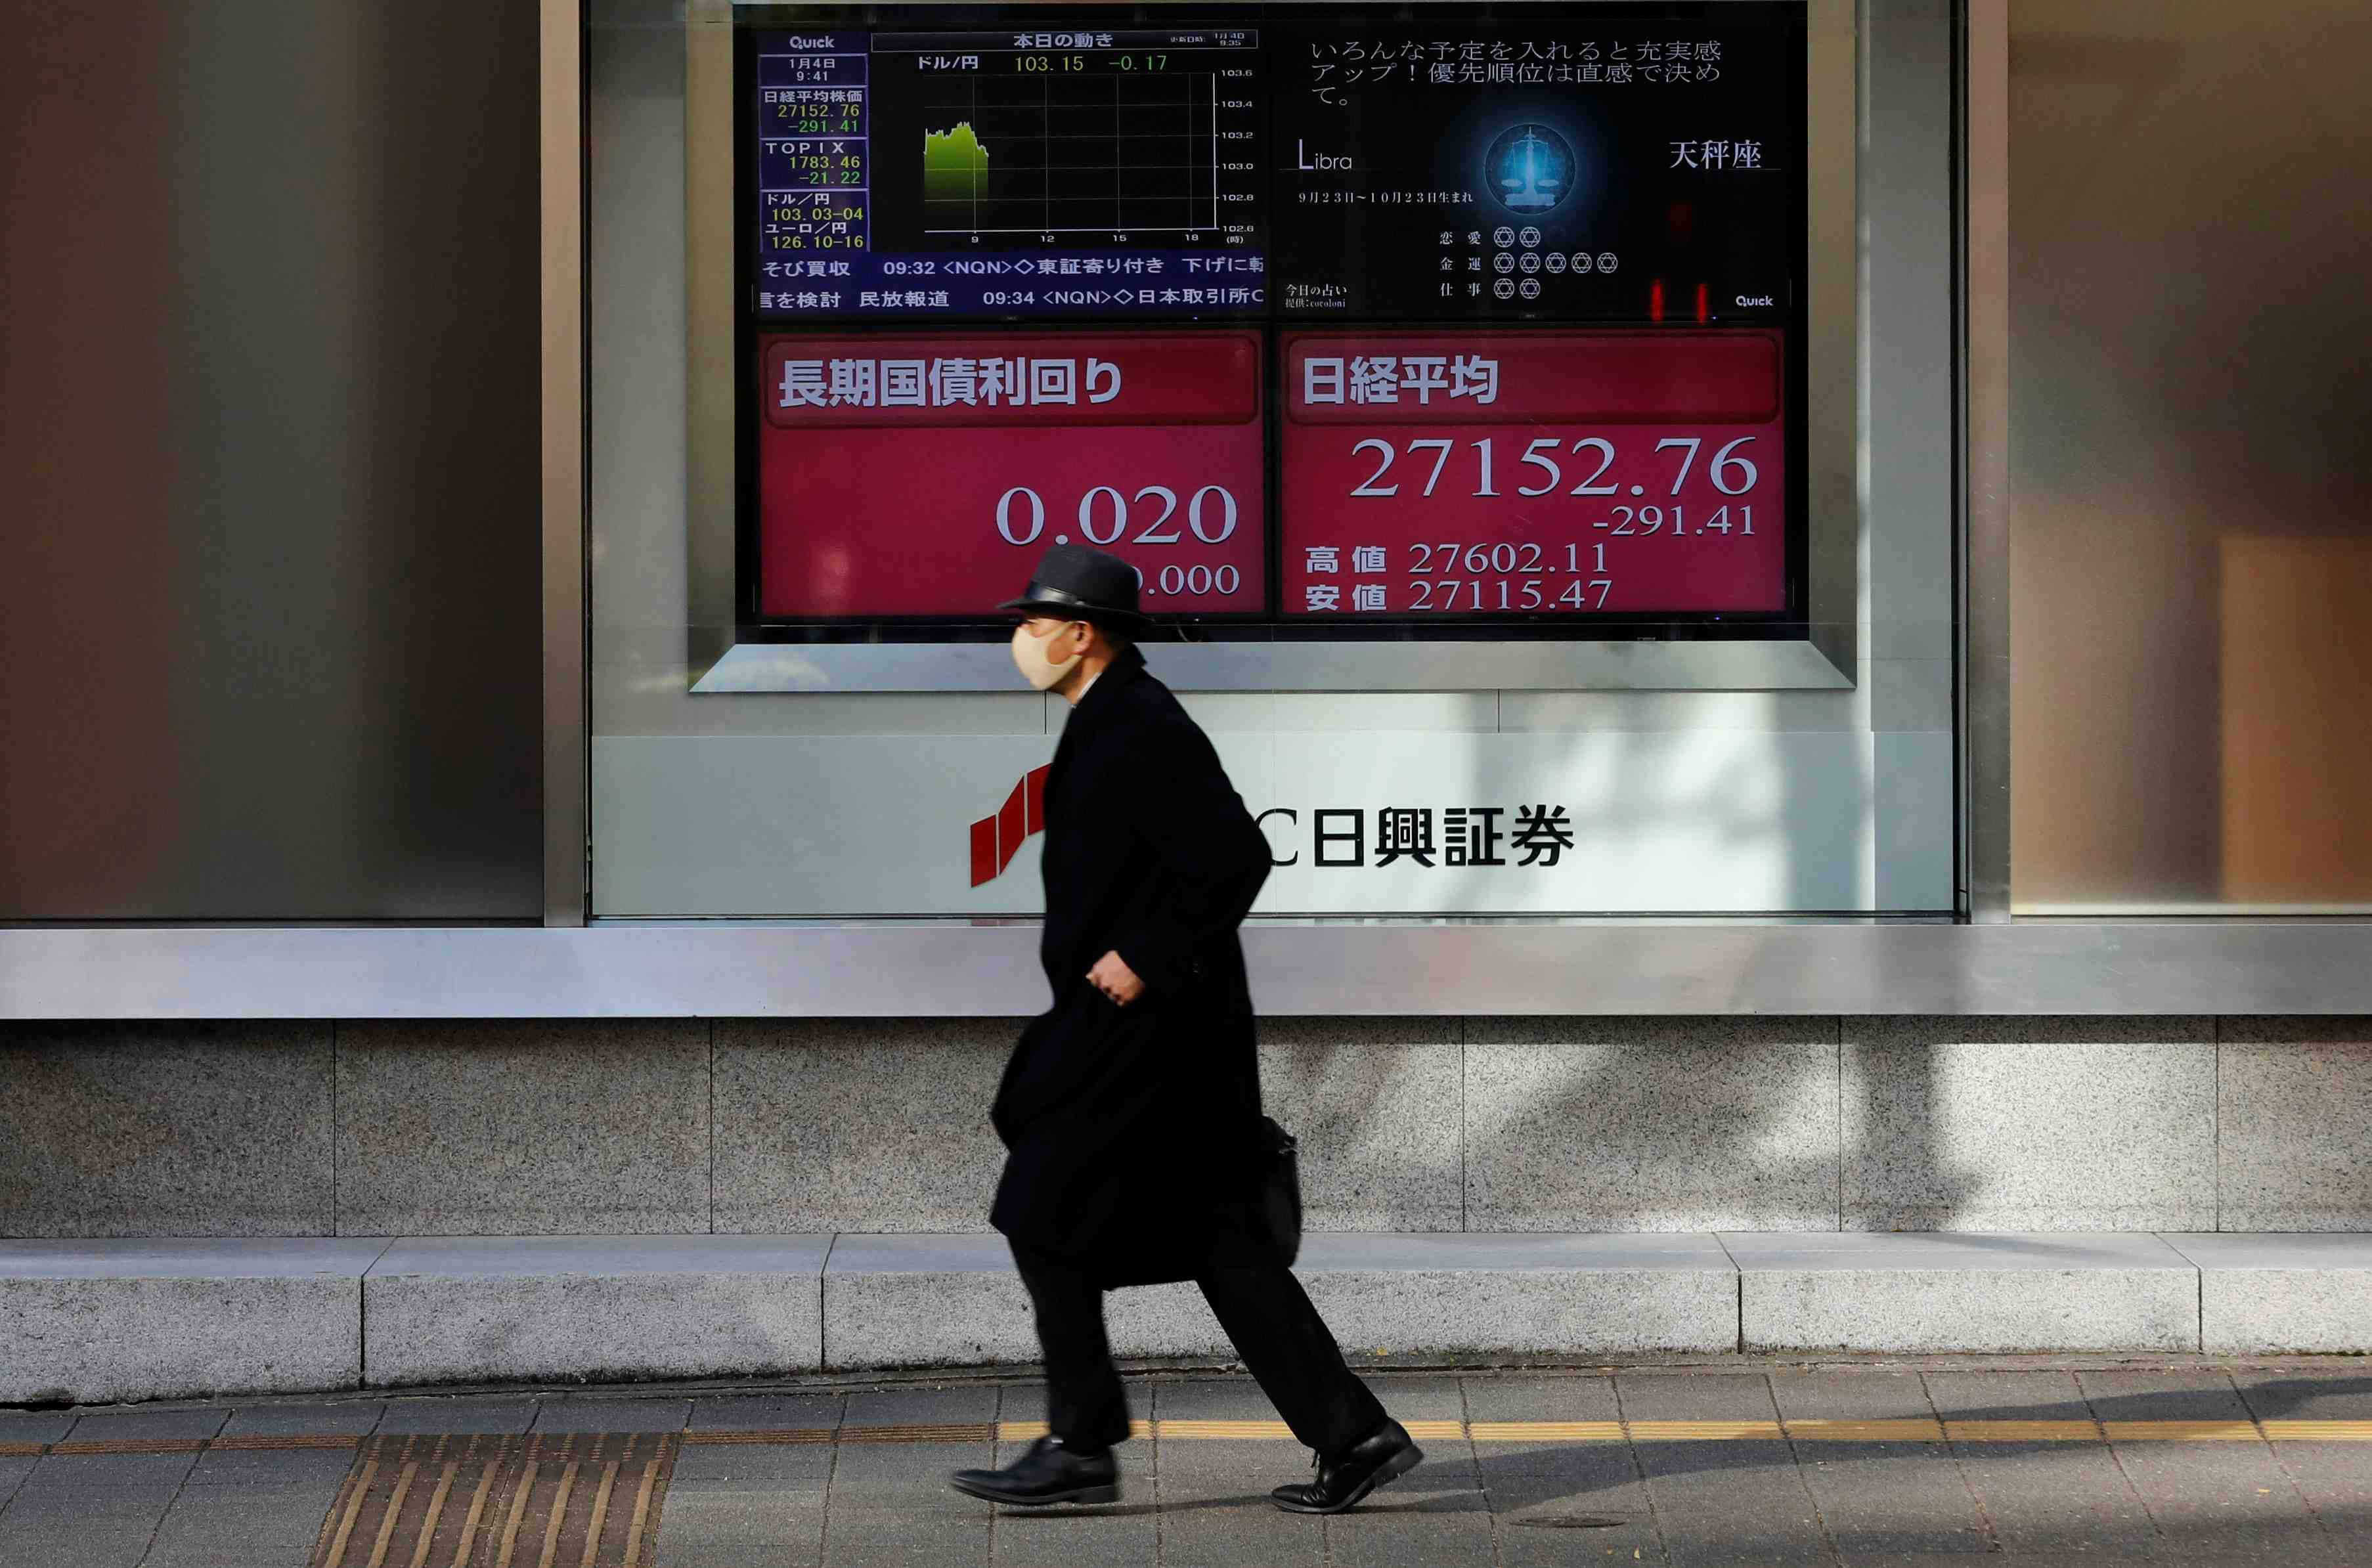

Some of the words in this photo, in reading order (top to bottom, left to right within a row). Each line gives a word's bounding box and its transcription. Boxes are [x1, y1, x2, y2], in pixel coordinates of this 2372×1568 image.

[789, 35, 835, 50] Quick
[1013, 33, 1114, 48] 本日の動き
[1311, 40, 1721, 61] いろんな予定を入れると充実感
[789, 58, 835, 69] 1月4日
[919, 55, 978, 70] ドル/円
[1015, 56, 1084, 72] 103.15
[1109, 55, 1167, 70] -0.17
[796, 71, 827, 81] 9:41
[1311, 62, 1720, 83] アップ！優先順位は直感で決め
[764, 90, 862, 103] 日経平均株価
[1311, 87, 1348, 106] て。
[778, 104, 860, 118] 27152.76
[787, 119, 860, 133] -291.41
[765, 142, 845, 154] TOPIX
[1298, 139, 1352, 170] Libra
[1669, 139, 1761, 169] 天秤座
[789, 156, 860, 169] 1783.46
[799, 171, 860, 185] -21.22
[772, 207, 864, 221] 103.03-04
[772, 235, 864, 249] 126.10-16
[762, 260, 850, 278] そび買収
[883, 261, 936, 275] 09:32
[1286, 283, 1347, 297] 今日の占い
[859, 290, 950, 307] 民放報道
[983, 291, 1035, 305] 09:34
[1736, 295, 1773, 307] Quick
[779, 357, 1122, 408] 長期国債利回り
[1304, 355, 1499, 405] 日経平均
[1350, 436, 1758, 497] 27152.76
[996, 485, 1238, 546] 0.020
[1593, 505, 1755, 536] -291.41
[1407, 542, 1608, 574] 27602.11
[1407, 580, 1612, 611] 27115.47
